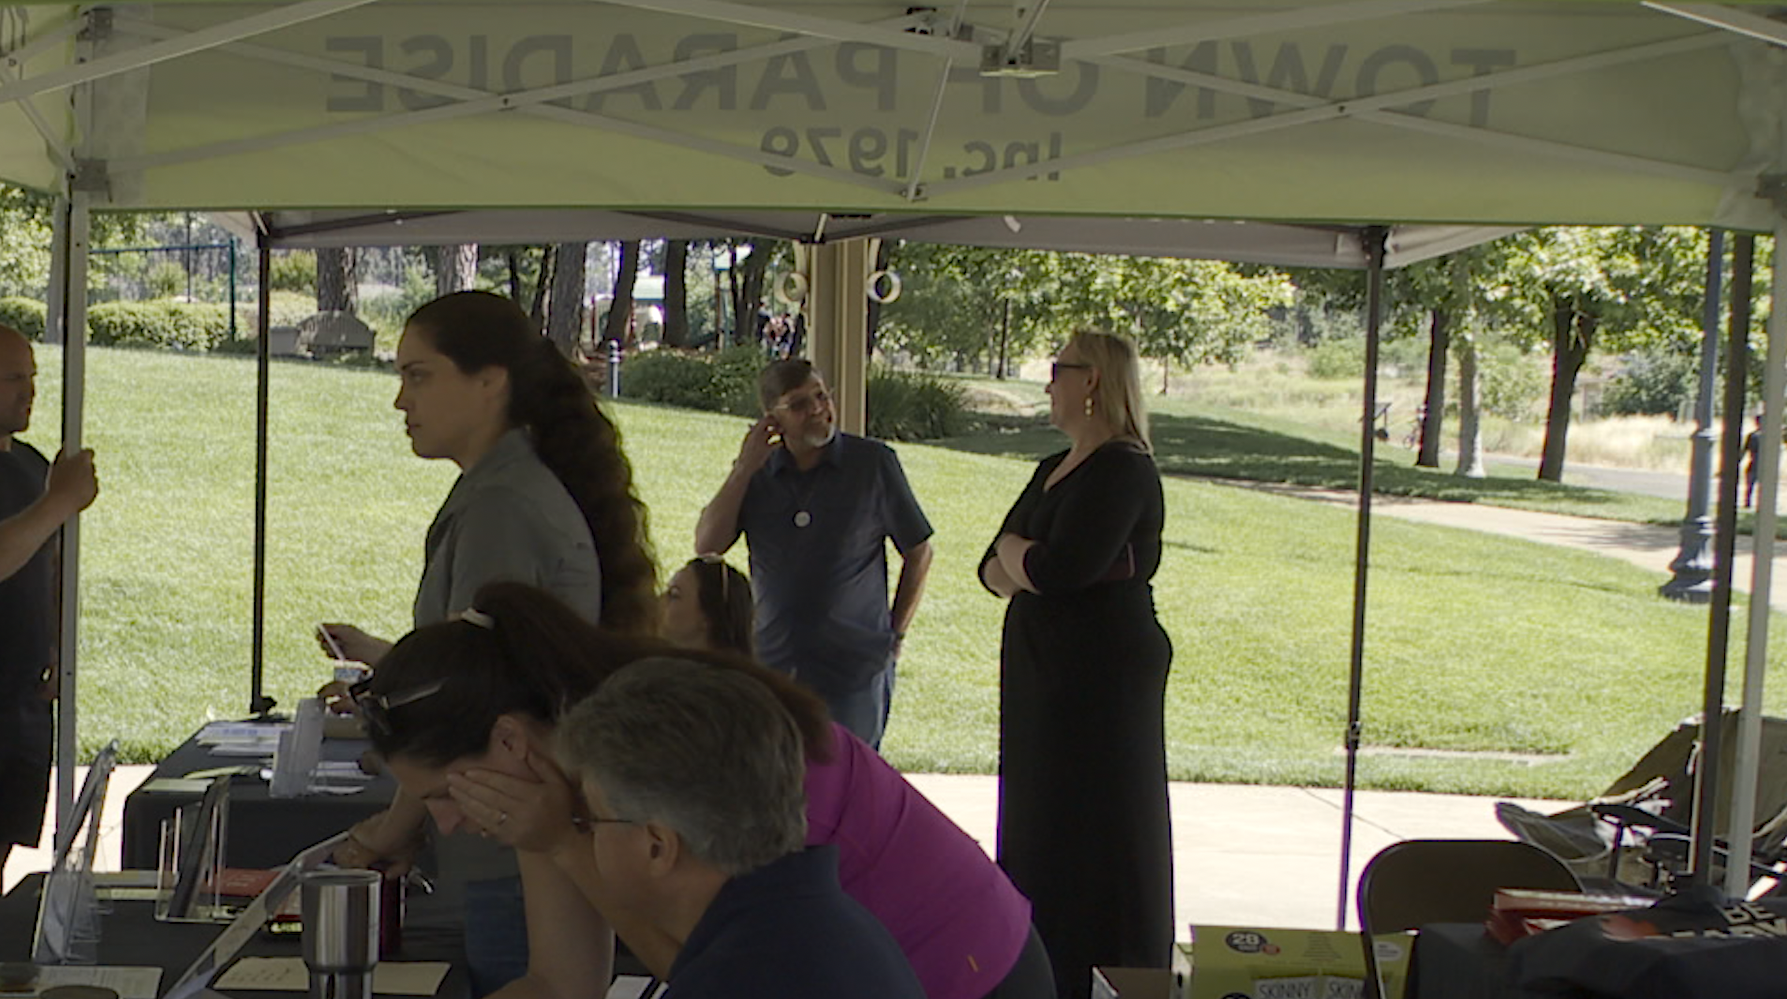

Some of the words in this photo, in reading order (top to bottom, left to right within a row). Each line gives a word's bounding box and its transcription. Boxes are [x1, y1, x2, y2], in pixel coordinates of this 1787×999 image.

[1231, 932, 1261, 947] 28
[1259, 981, 1312, 999] SKINNY
[1329, 980, 1364, 999] SKIN
